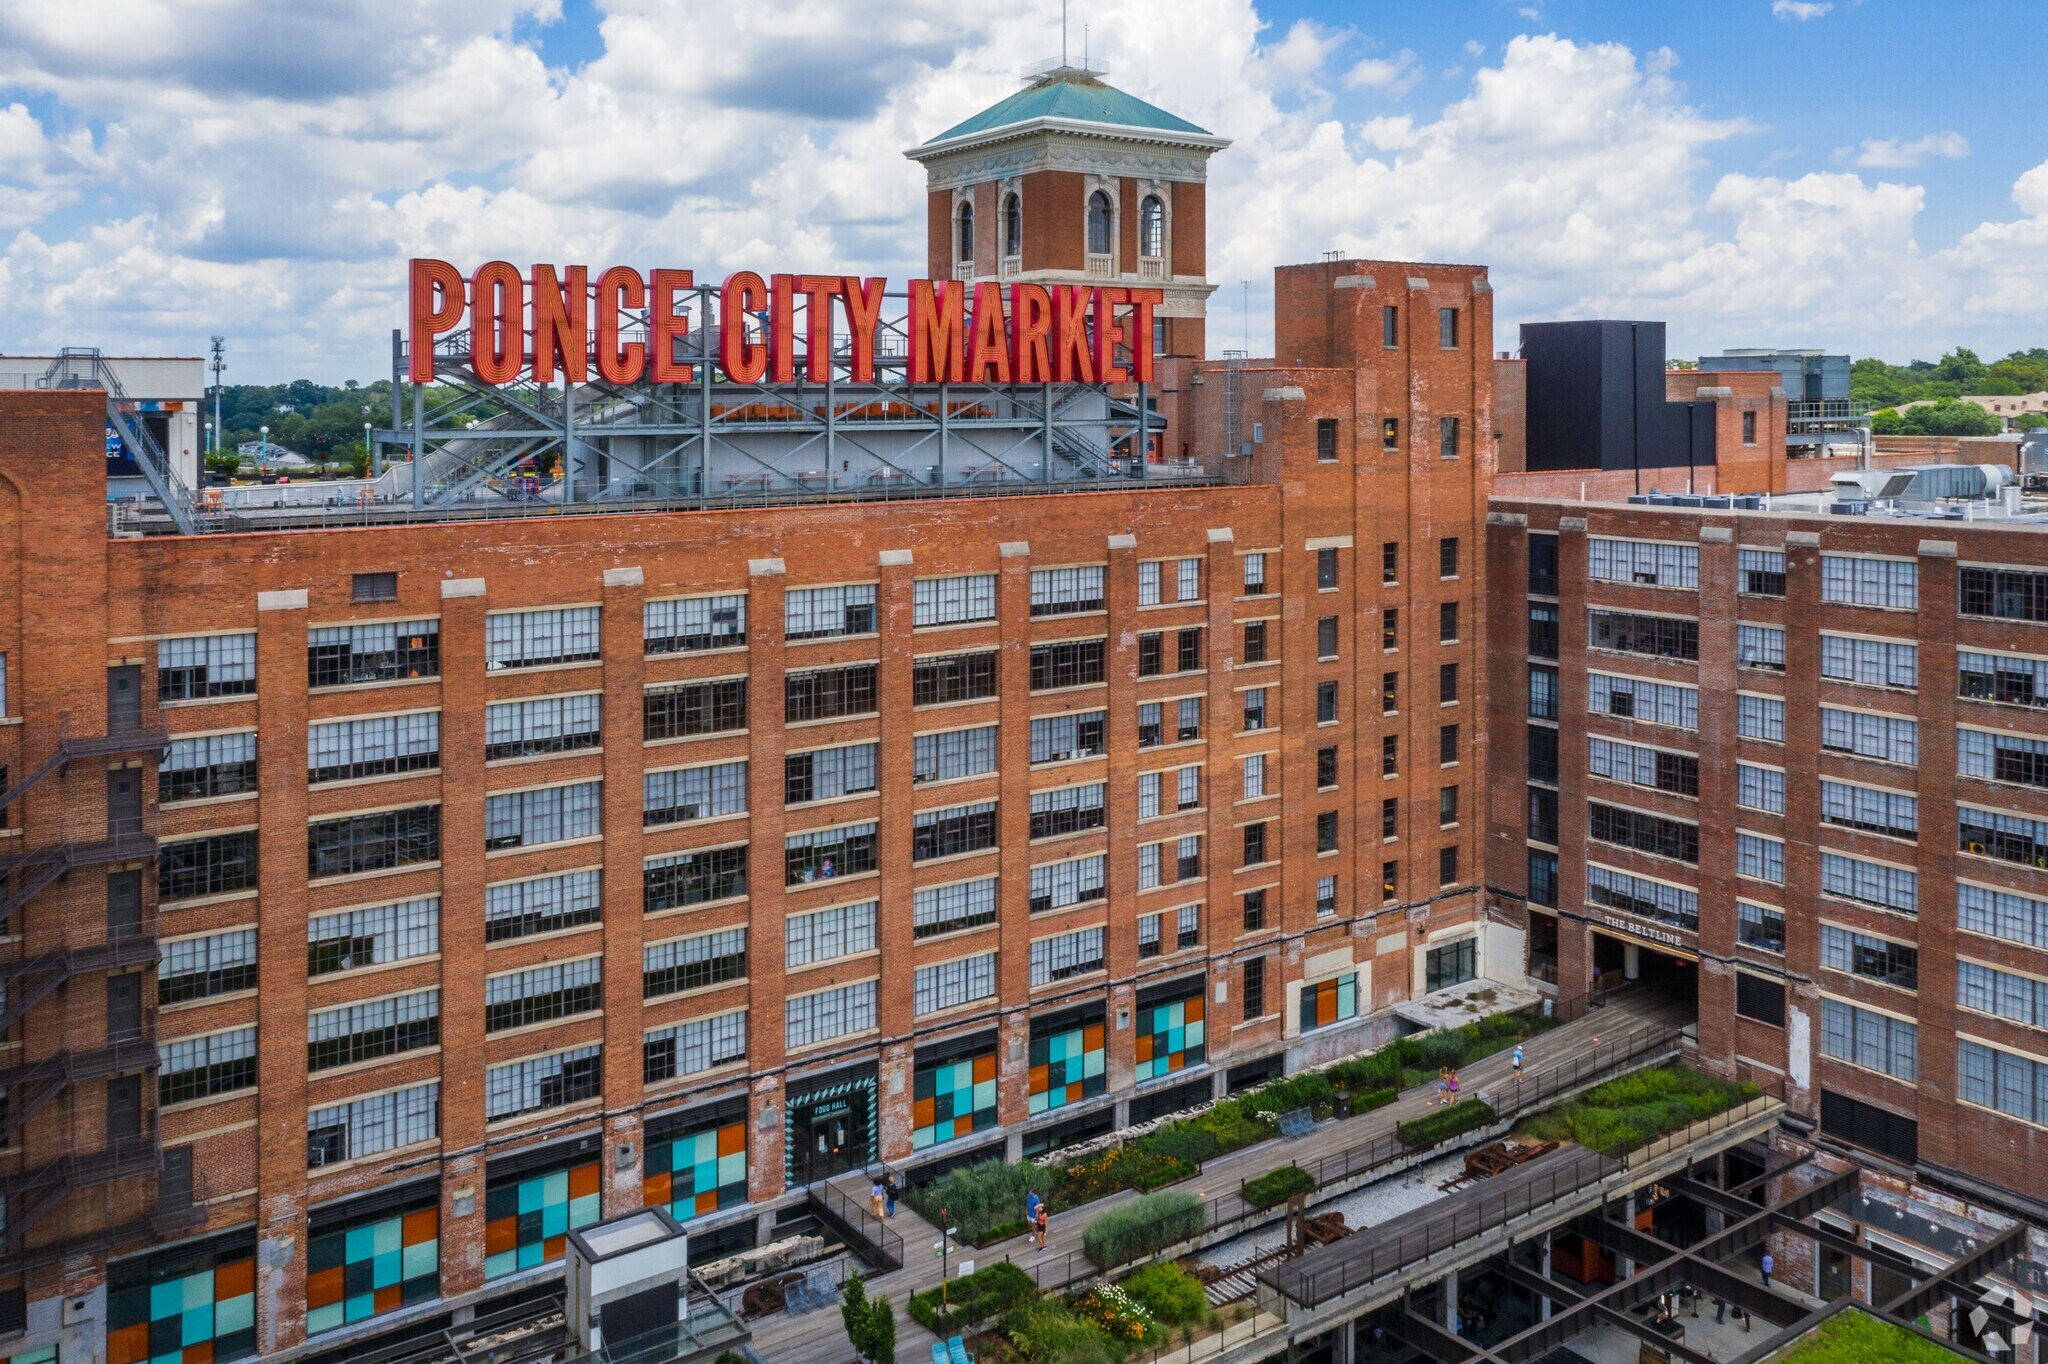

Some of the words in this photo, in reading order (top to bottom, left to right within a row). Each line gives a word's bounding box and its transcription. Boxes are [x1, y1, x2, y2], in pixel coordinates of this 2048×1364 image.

[410, 258, 693, 384] PONCE
[720, 271, 887, 383] CITY
[908, 278, 1164, 383] MARKET
[1604, 915, 1625, 930] THE
[1628, 922, 1682, 947] BELTLINE
[815, 1104, 830, 1116] FOOD
[831, 1099, 847, 1110] HALL
